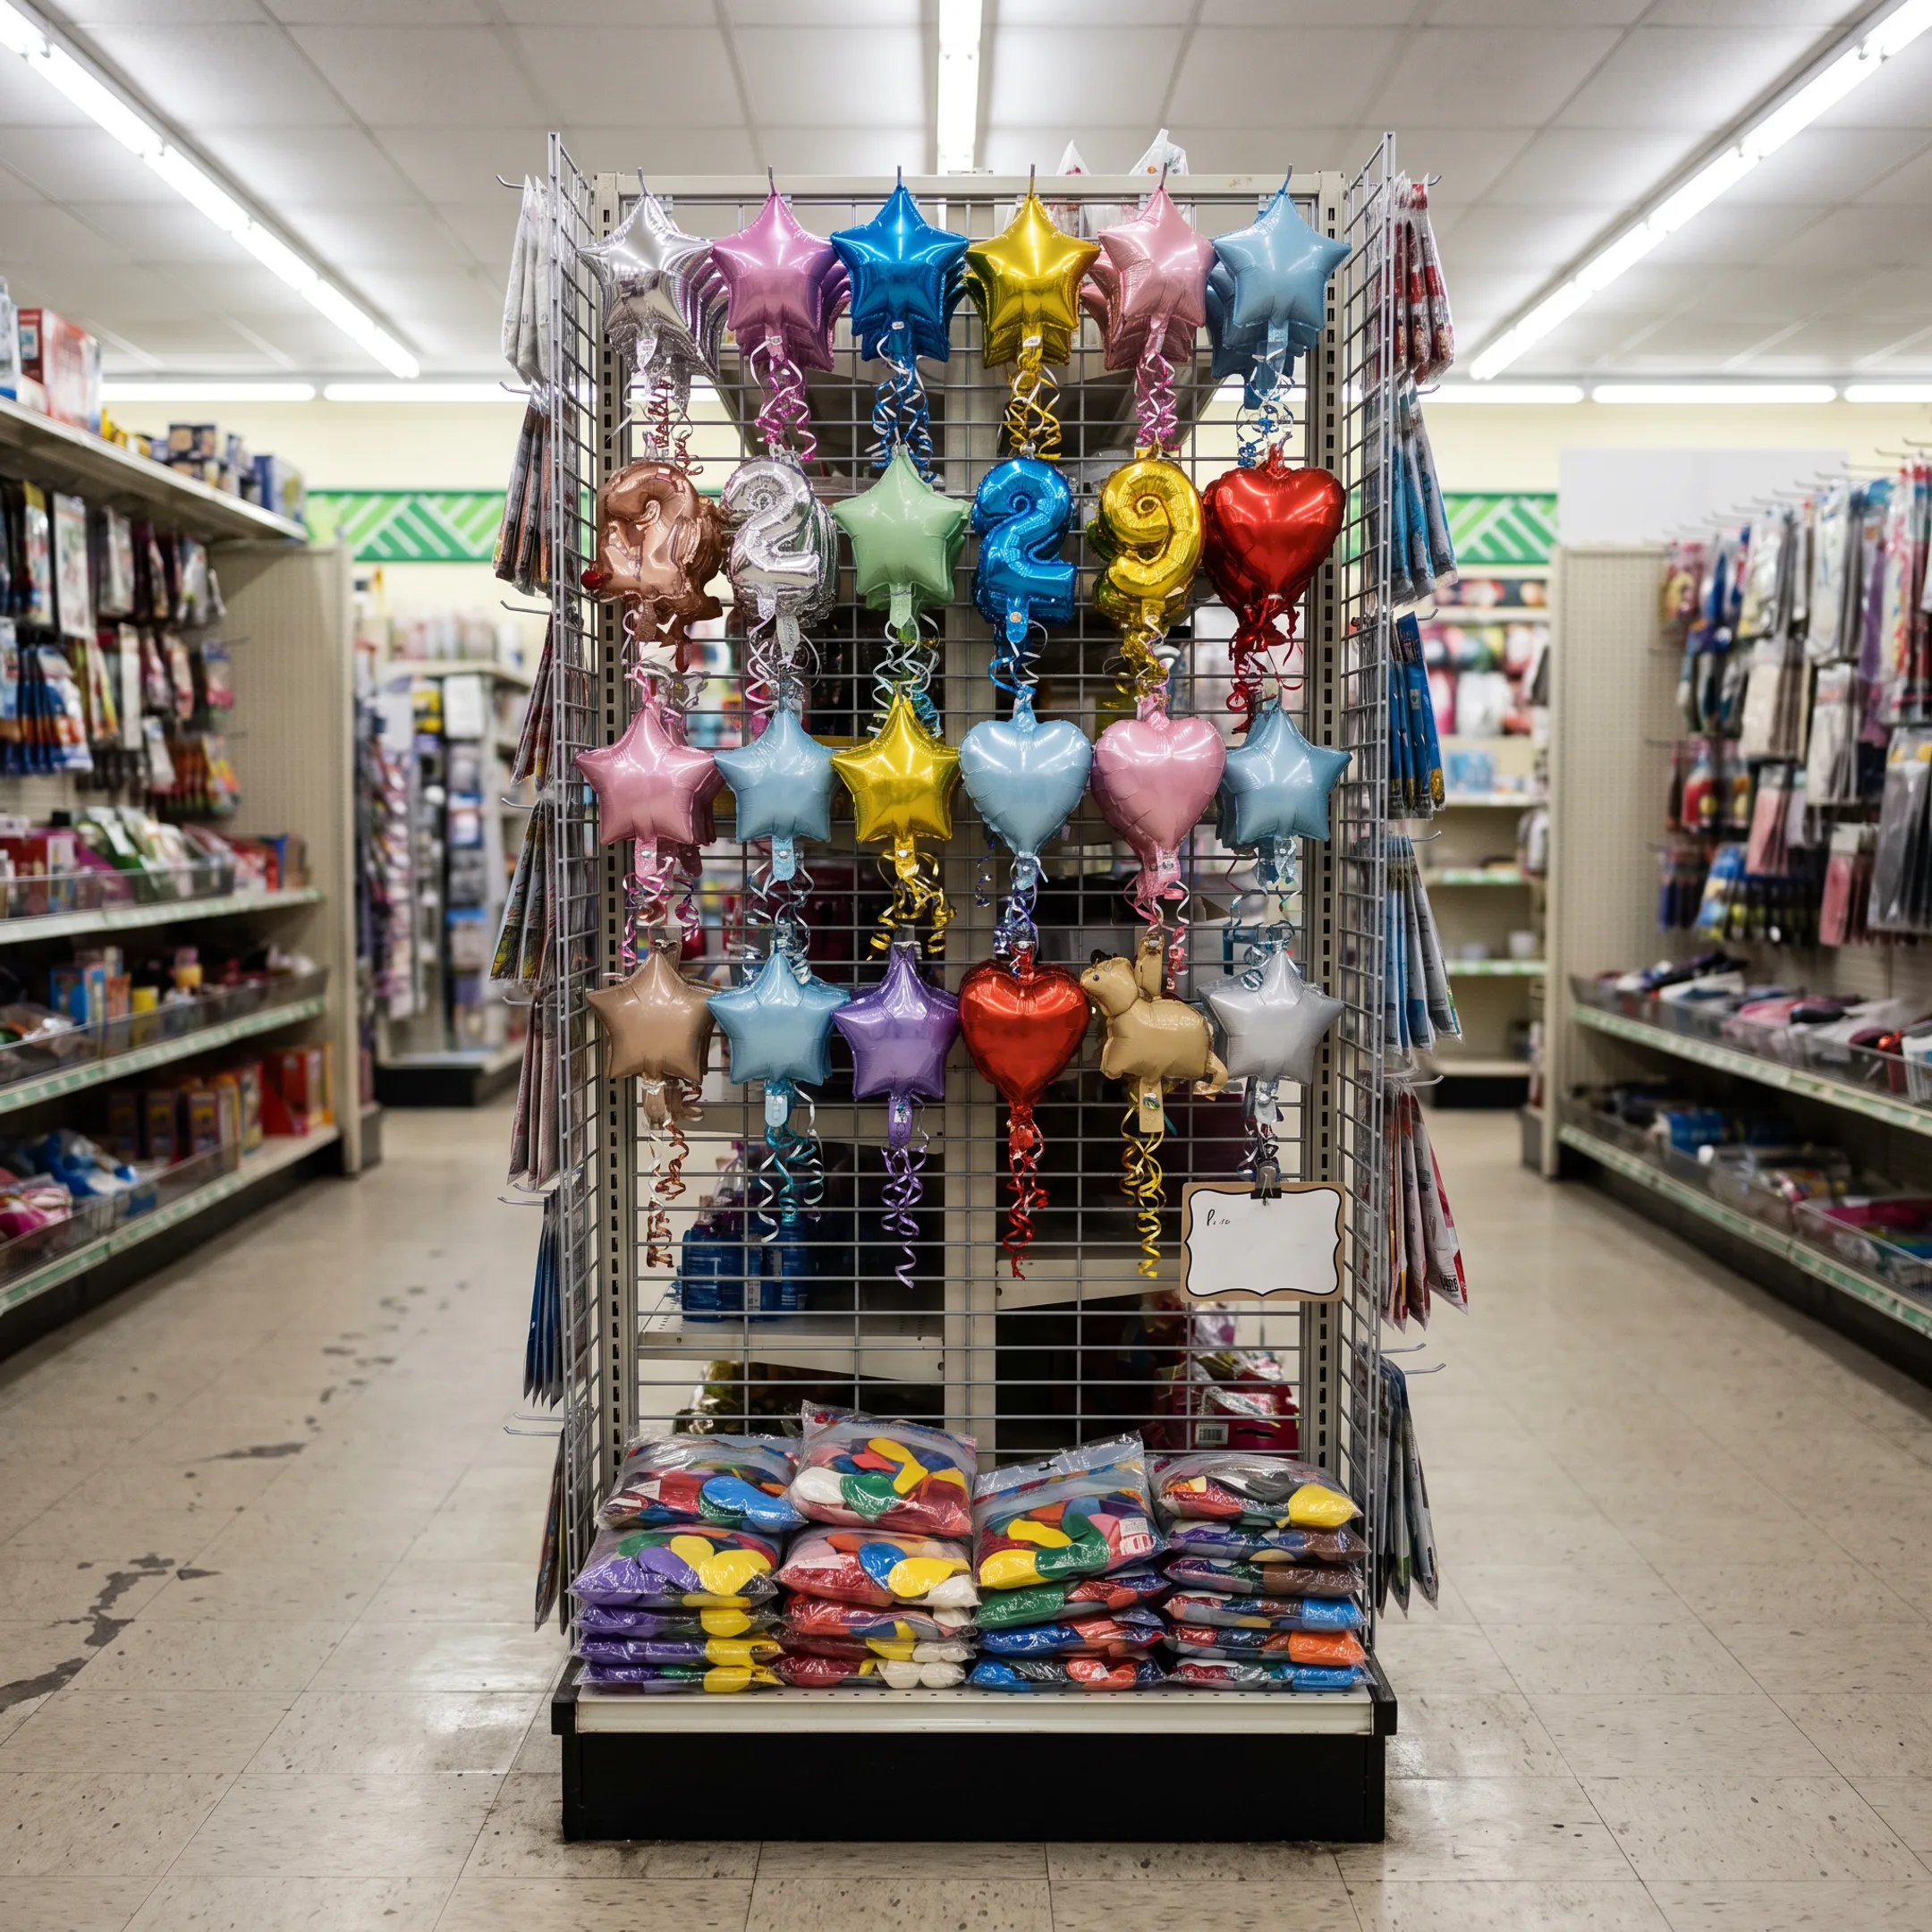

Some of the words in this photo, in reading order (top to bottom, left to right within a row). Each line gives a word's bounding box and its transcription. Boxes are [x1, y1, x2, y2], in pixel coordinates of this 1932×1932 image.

[721, 456, 821, 589] 2
[973, 456, 1077, 601] 2
[1100, 458, 1206, 601] 9
